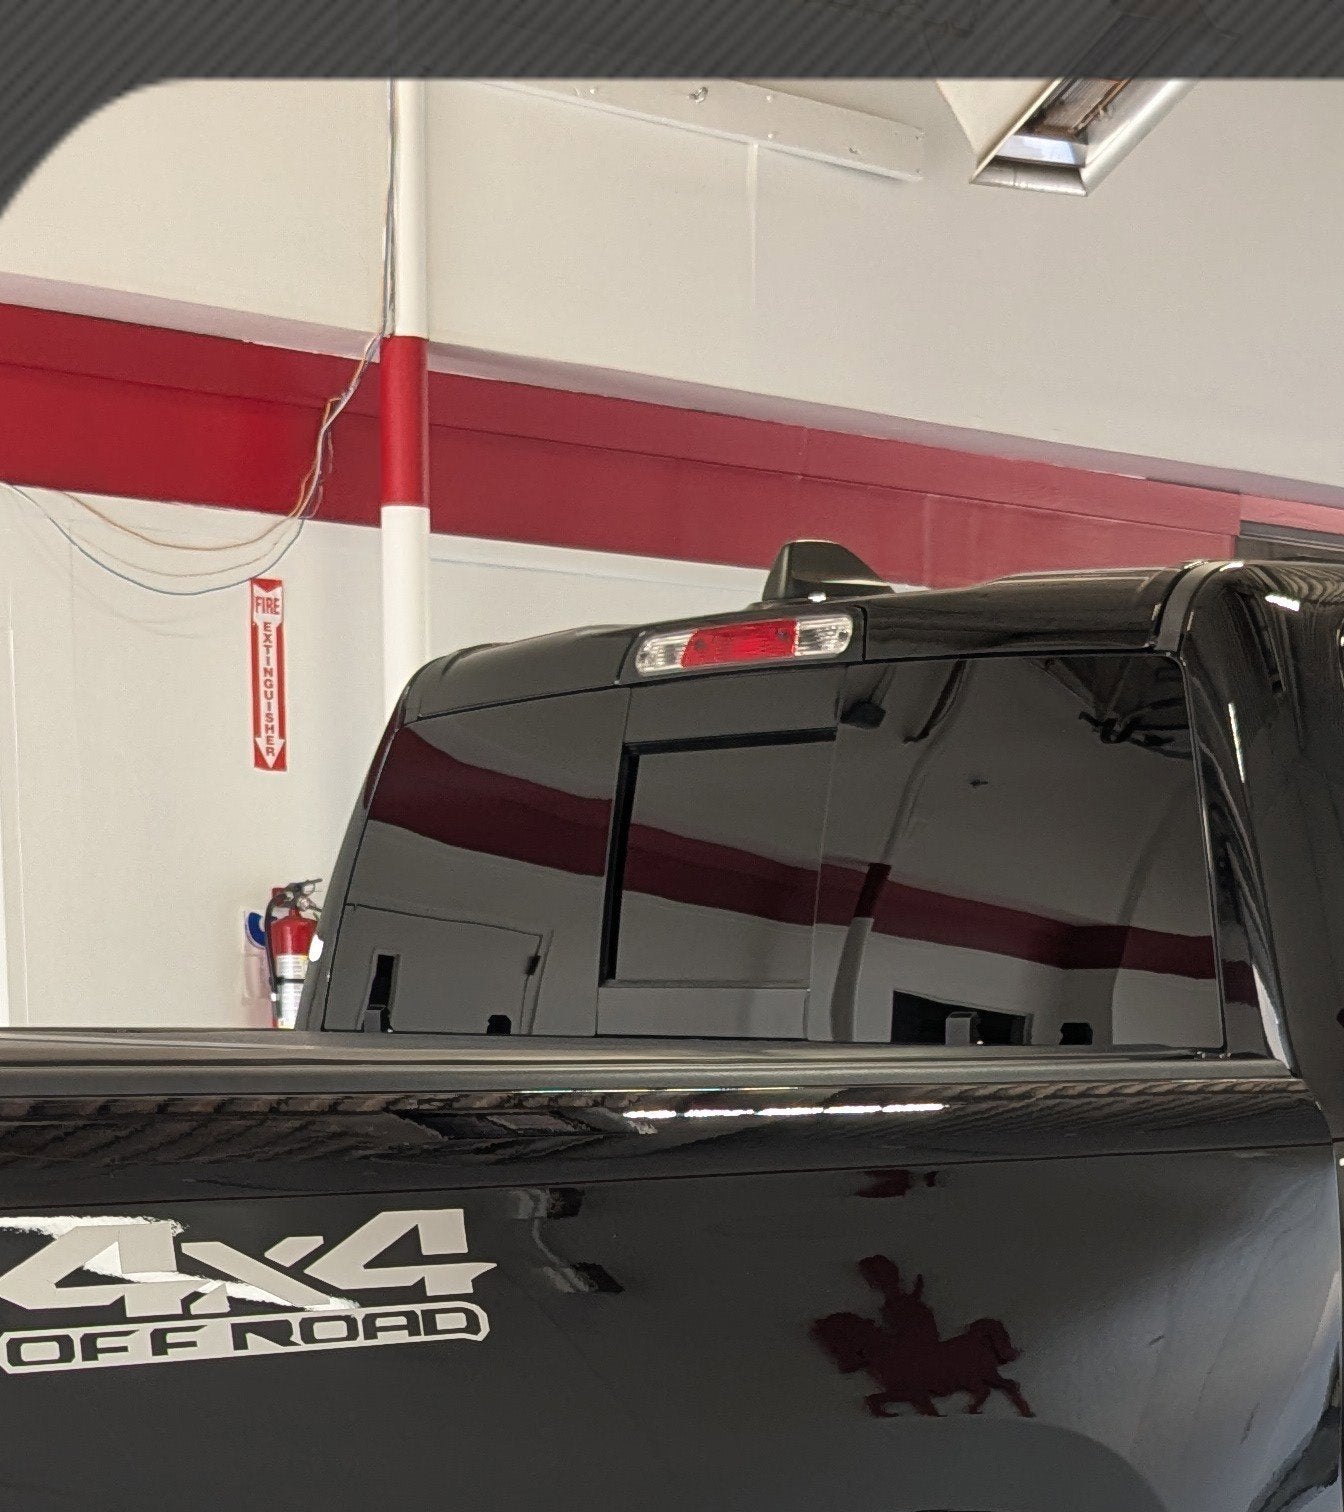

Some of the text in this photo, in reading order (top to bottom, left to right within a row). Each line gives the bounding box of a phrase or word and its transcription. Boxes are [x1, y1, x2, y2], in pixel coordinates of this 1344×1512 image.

[254, 595, 280, 615] FIRE
[262, 621, 276, 757] EXTINGUISHER
[6, 1306, 483, 1368] OFF ROAD
